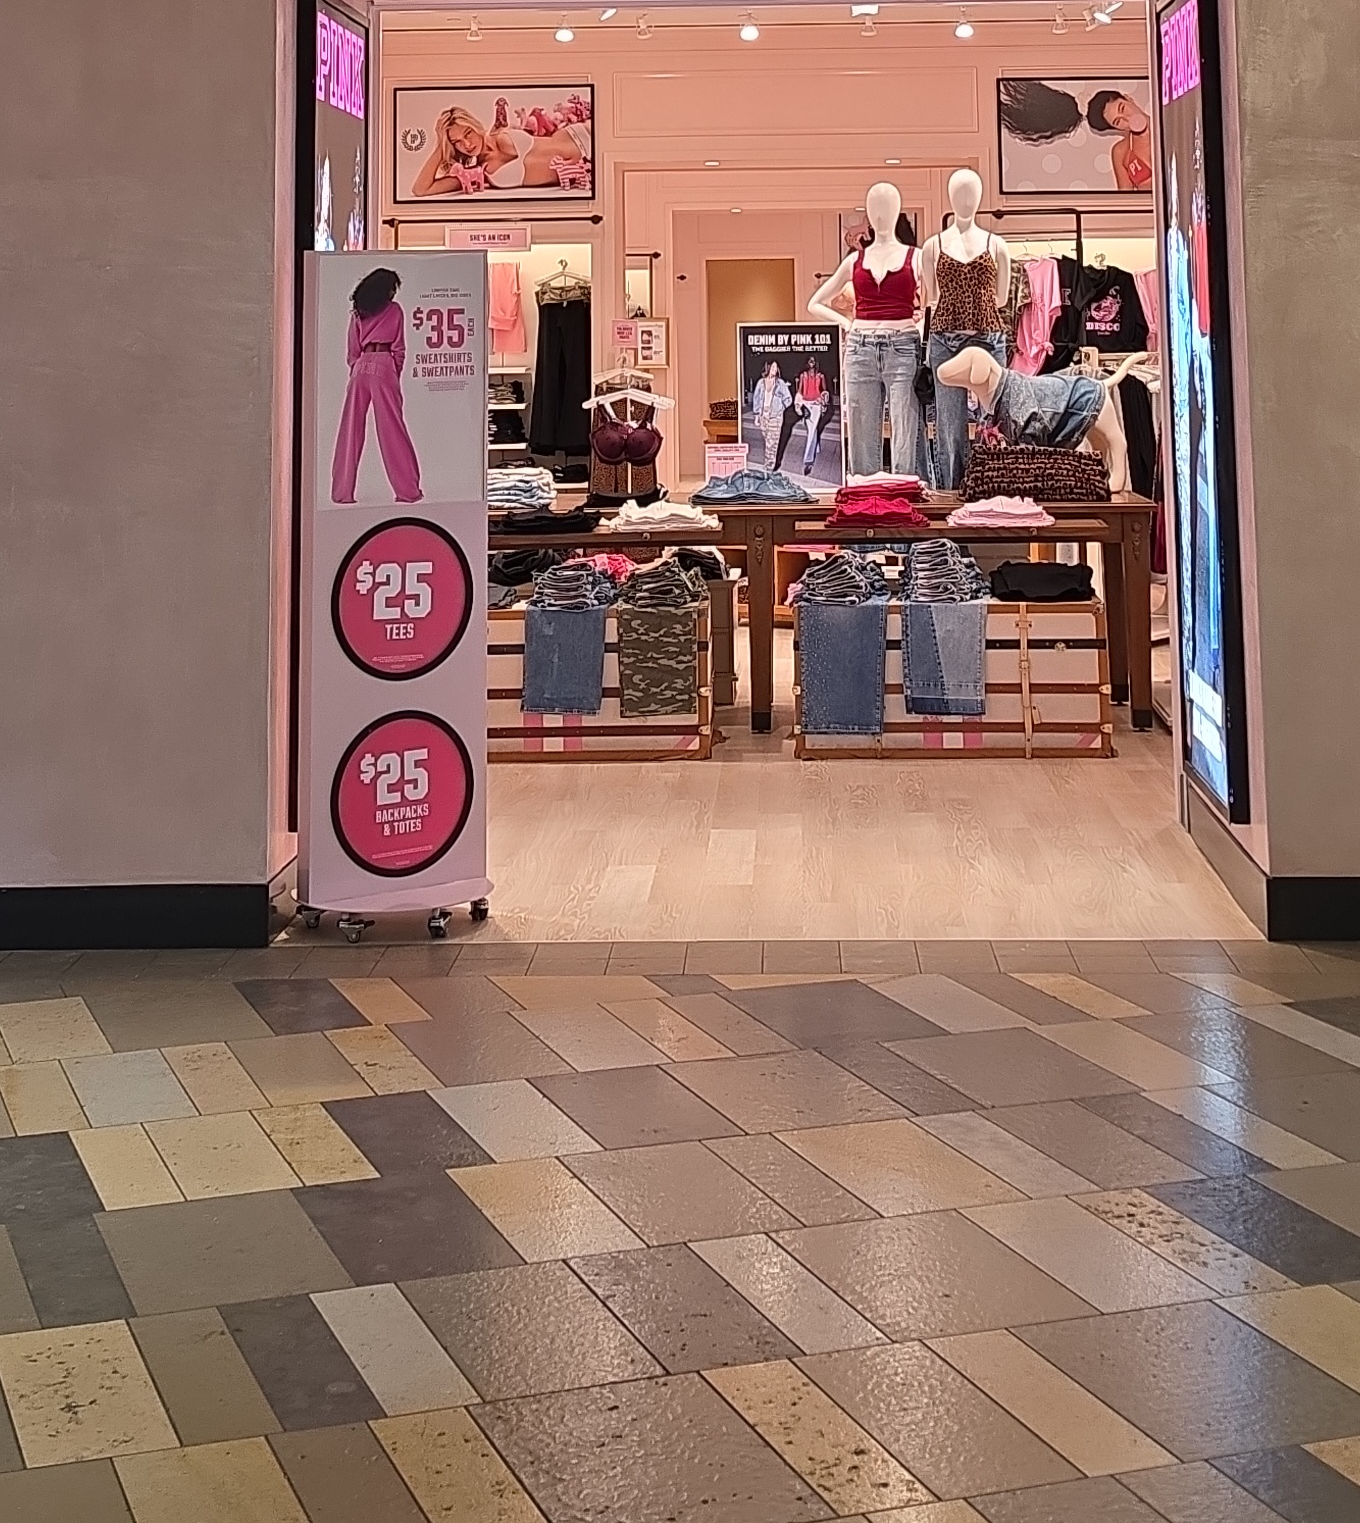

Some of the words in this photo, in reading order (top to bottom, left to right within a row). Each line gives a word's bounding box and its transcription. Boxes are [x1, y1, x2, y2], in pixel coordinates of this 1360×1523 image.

[316, 11, 365, 120] PINK
[412, 306, 466, 349] $35
[467, 317, 475, 337] EACH
[1085, 322, 1120, 332] DISCO
[747, 334, 776, 345] DENIM
[777, 334, 790, 345] BY
[790, 333, 813, 345] PINK
[814, 333, 832, 345] 101
[415, 352, 473, 364] SWEATSHIRTS
[412, 366, 419, 378] &
[421, 364, 475, 378] SWEATPANTS
[355, 560, 433, 621] $25
[384, 622, 415, 640] TEES
[359, 747, 429, 807] $25
[375, 803, 429, 824] BACKPACKS
[383, 823, 391, 836] &
[393, 818, 422, 835] TOTES
